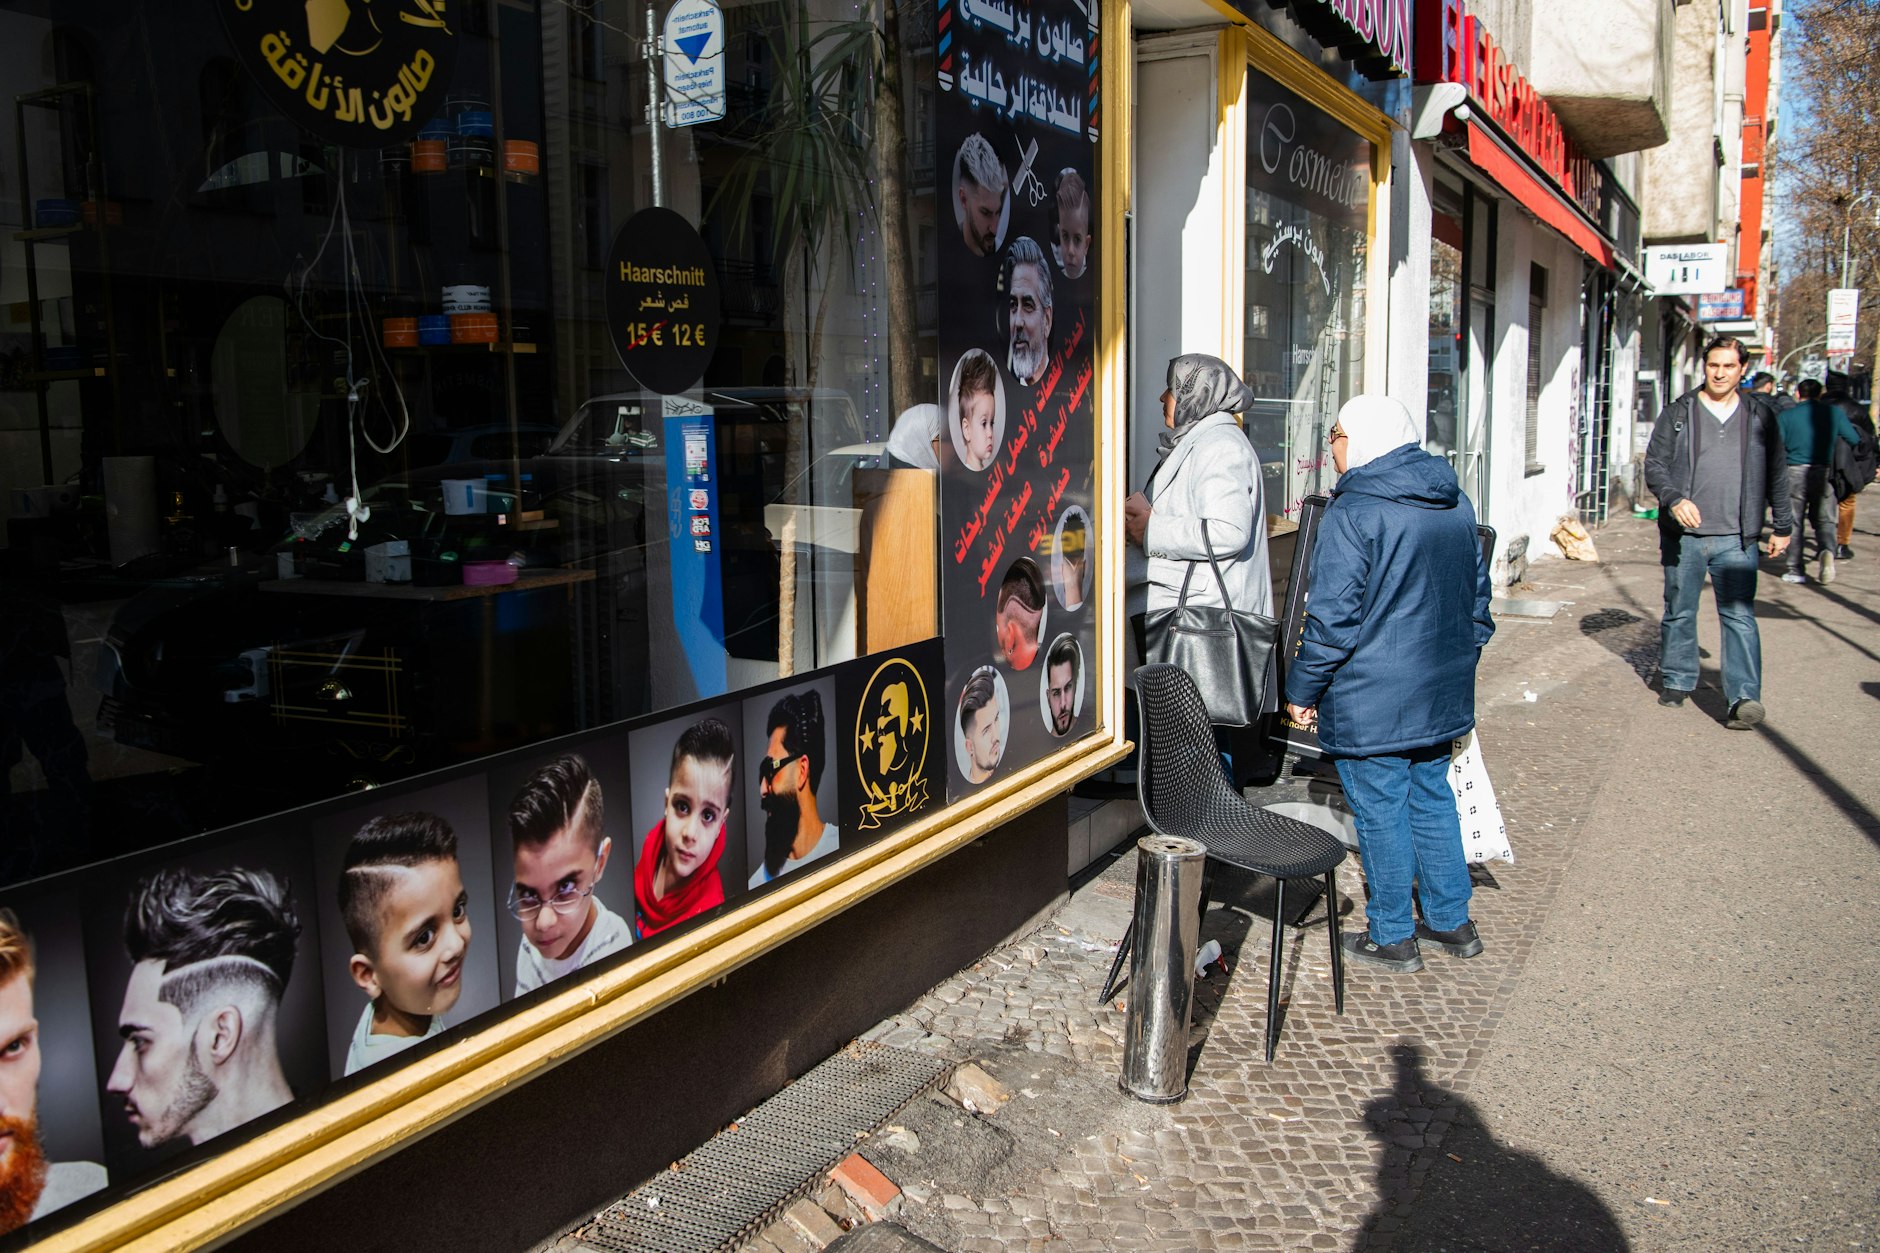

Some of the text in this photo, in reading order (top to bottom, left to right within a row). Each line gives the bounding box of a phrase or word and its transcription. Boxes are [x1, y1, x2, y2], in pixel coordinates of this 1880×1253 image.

[1037, 15, 1084, 64] صالون
[260, 30, 435, 130] صالون الأناقة
[960, 51, 1081, 134] للحلاقة الرجالية
[620, 261, 705, 286] Haarschnitt
[639, 290, 689, 312] قص شعر
